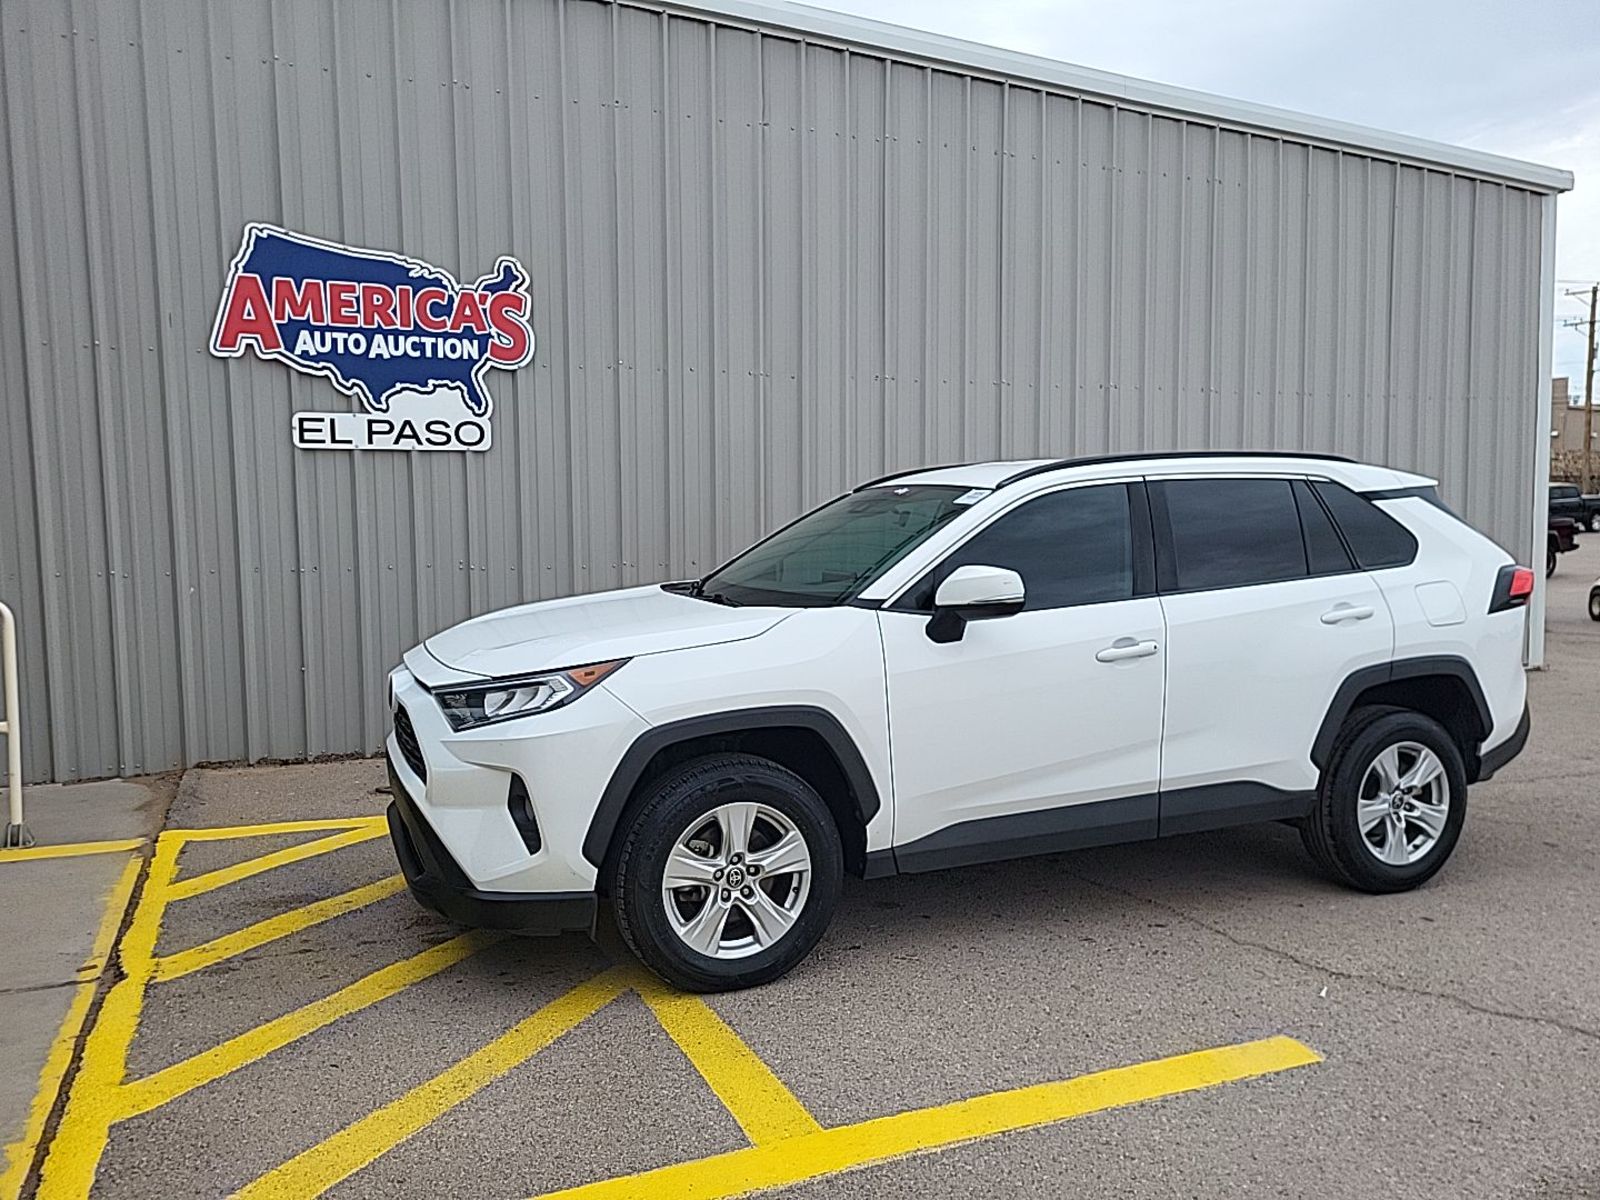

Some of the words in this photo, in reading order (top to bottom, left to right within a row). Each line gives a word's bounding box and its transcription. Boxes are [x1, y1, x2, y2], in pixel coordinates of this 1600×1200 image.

[216, 273, 528, 362] AMERICA'S
[294, 329, 366, 356] AUTO
[368, 334, 479, 360] AUCTION
[298, 417, 353, 444] EL
[367, 419, 485, 446] PASO
